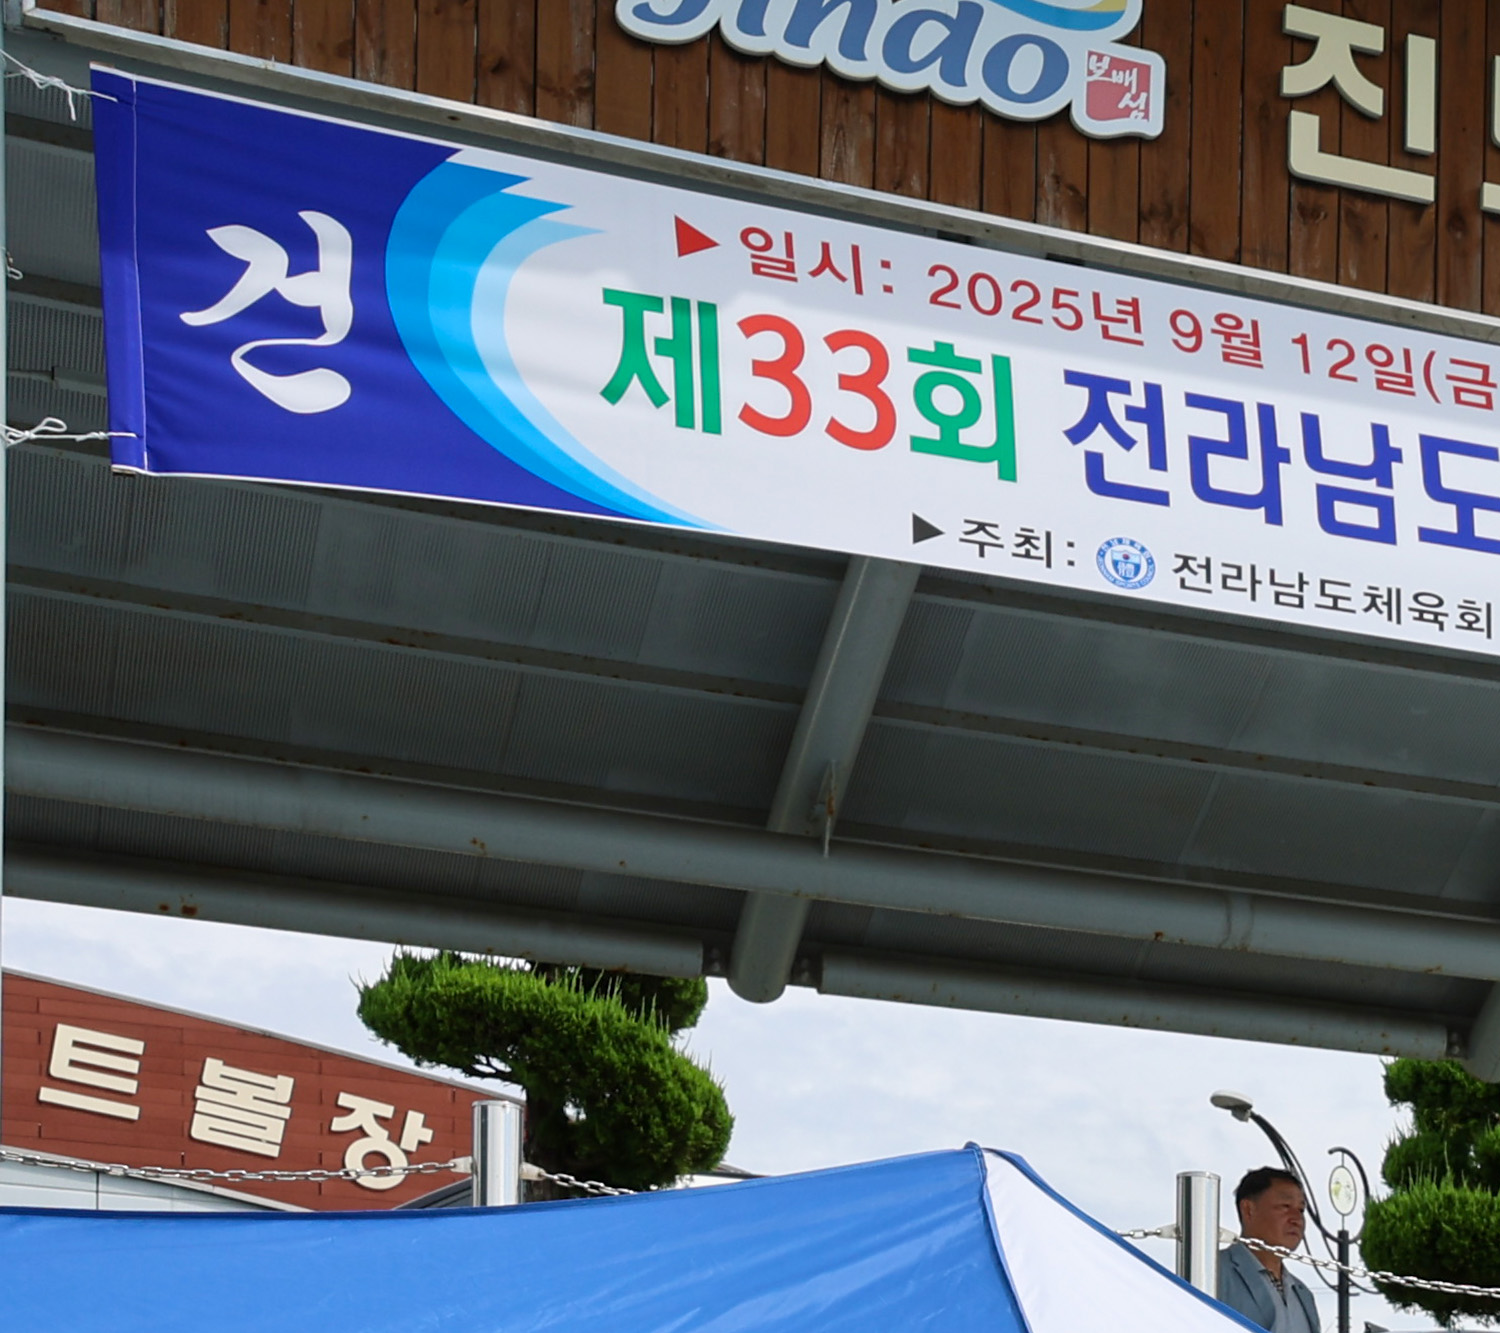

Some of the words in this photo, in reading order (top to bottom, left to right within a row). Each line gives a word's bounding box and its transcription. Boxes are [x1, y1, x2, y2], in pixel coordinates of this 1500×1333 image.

[632, 0, 1070, 104] indo
[180, 212, 352, 413] 건
[741, 227, 892, 294] 일시:
[929, 265, 1143, 345] 2025년
[1171, 310, 1262, 368] 9월
[600, 288, 1017, 483] 제33회
[960, 520, 1074, 568] 주최:
[1174, 554, 1491, 639] 전라남도체육회
[37, 1022, 435, 1192] 트볼장
